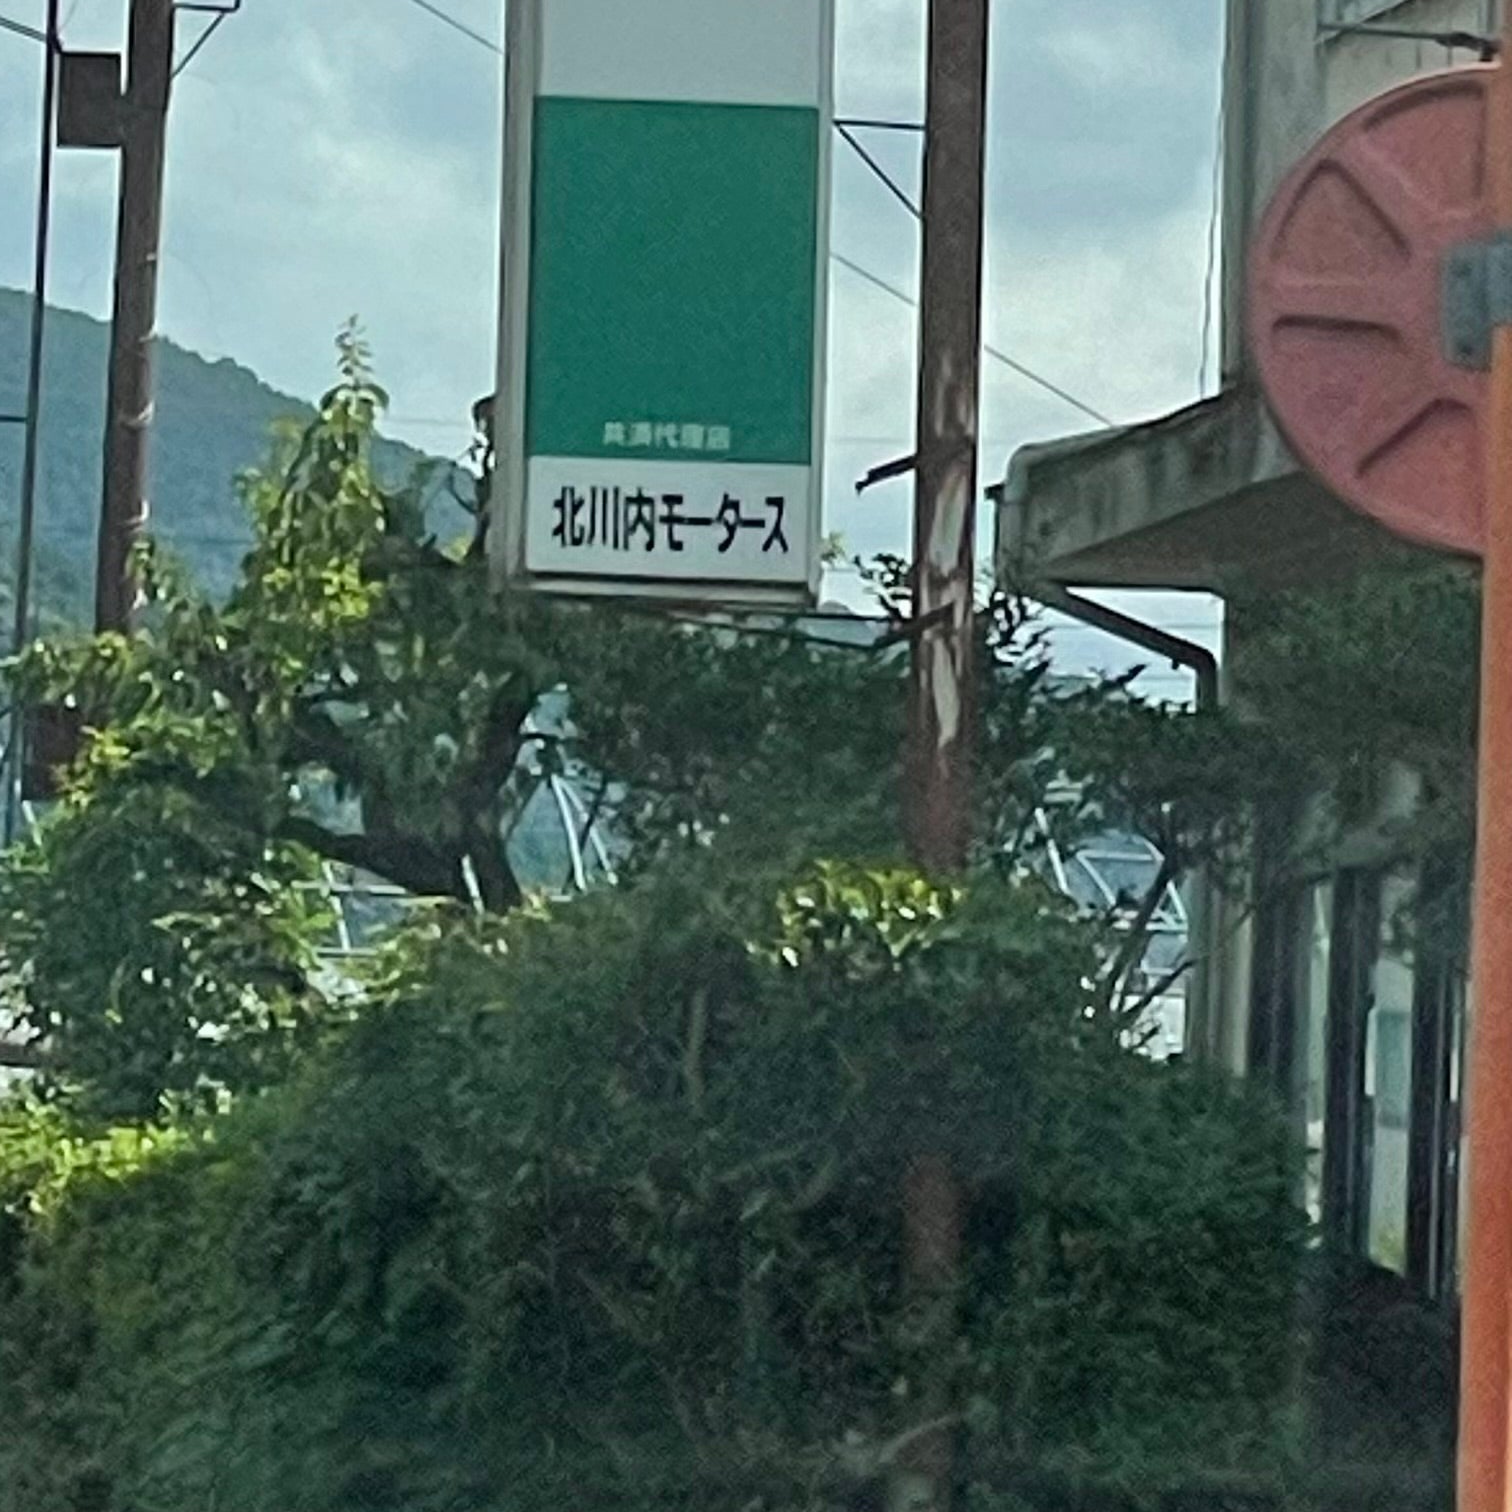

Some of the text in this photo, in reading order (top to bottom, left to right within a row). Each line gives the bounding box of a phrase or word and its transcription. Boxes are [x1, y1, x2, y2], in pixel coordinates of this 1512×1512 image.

[552, 486, 789, 553] 北川内モータース
